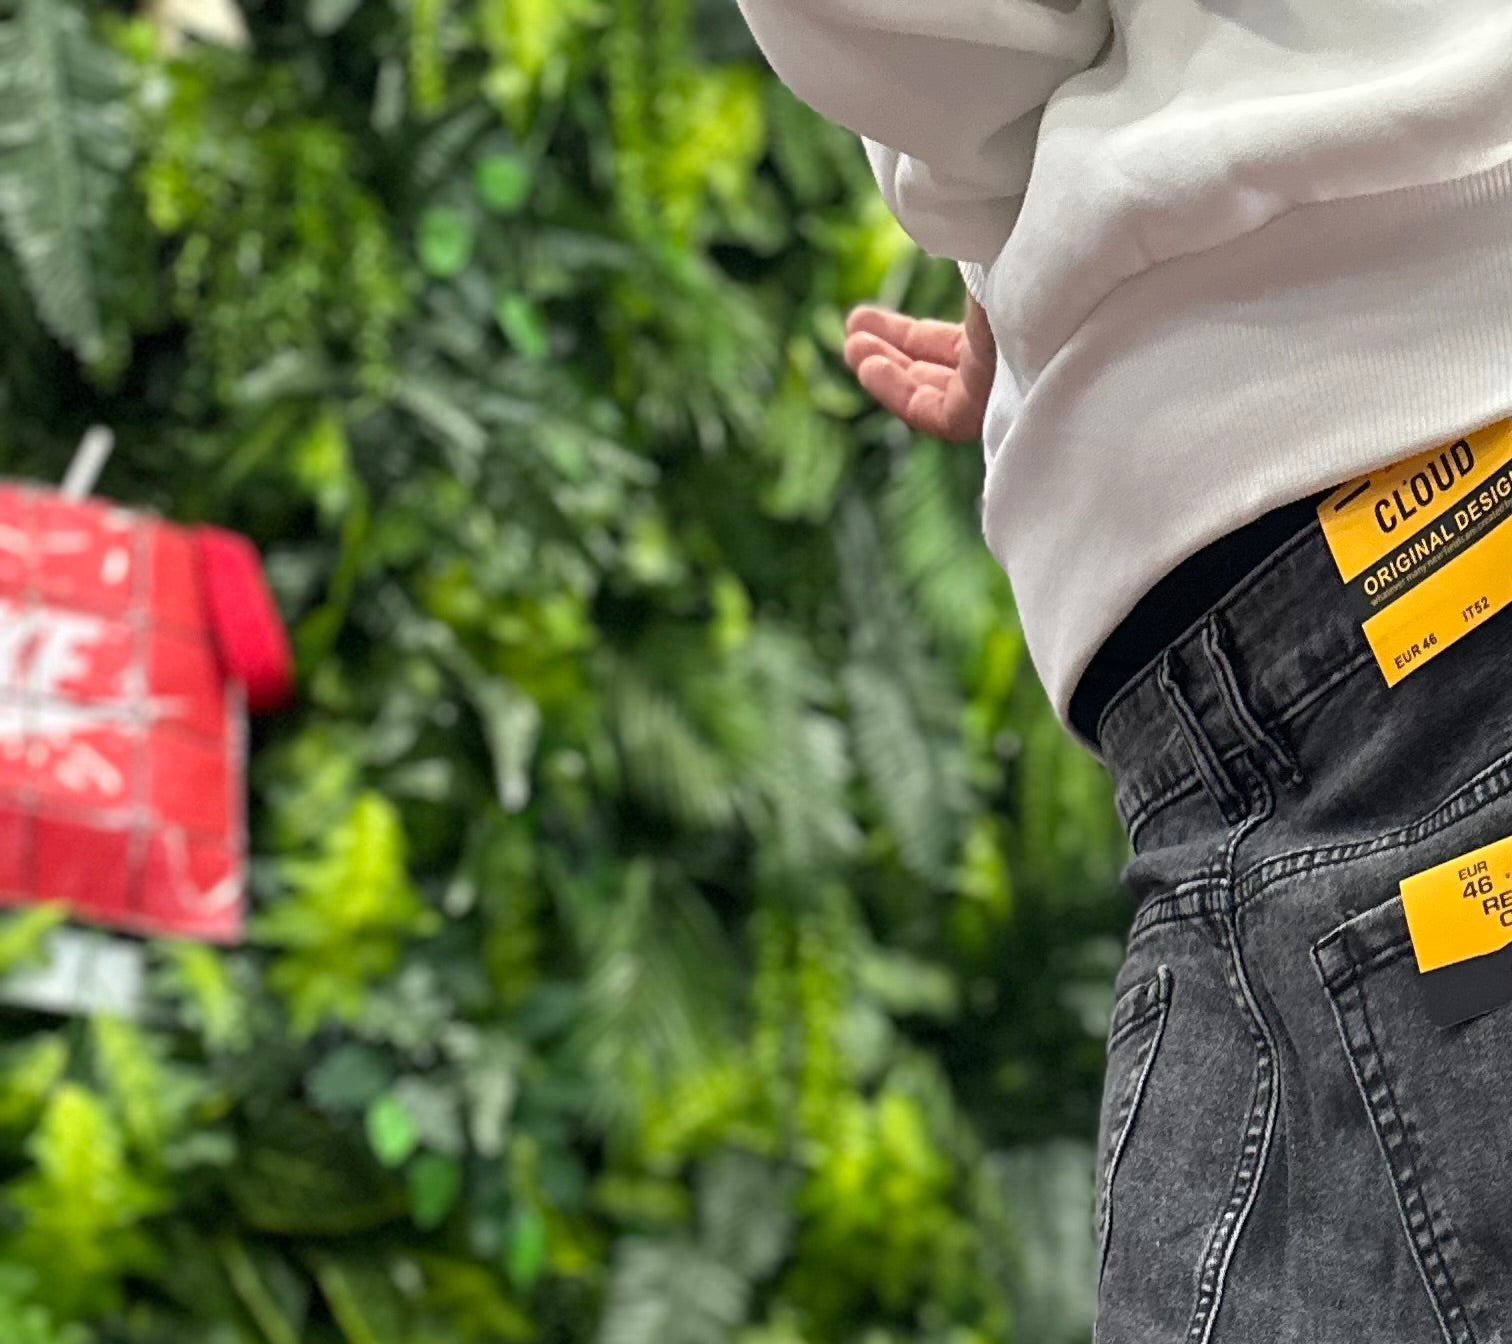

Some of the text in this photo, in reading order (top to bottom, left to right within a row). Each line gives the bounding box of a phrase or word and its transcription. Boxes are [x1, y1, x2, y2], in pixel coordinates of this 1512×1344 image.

[1374, 439, 1475, 534] CLOUD
[1363, 525, 1454, 596] ORIGINAL
[1393, 644, 1422, 669] EUR
[1423, 632, 1438, 650] 46
[1462, 596, 1490, 622] IT52
[1458, 861, 1488, 881] EUR
[1463, 875, 1493, 899] 46
